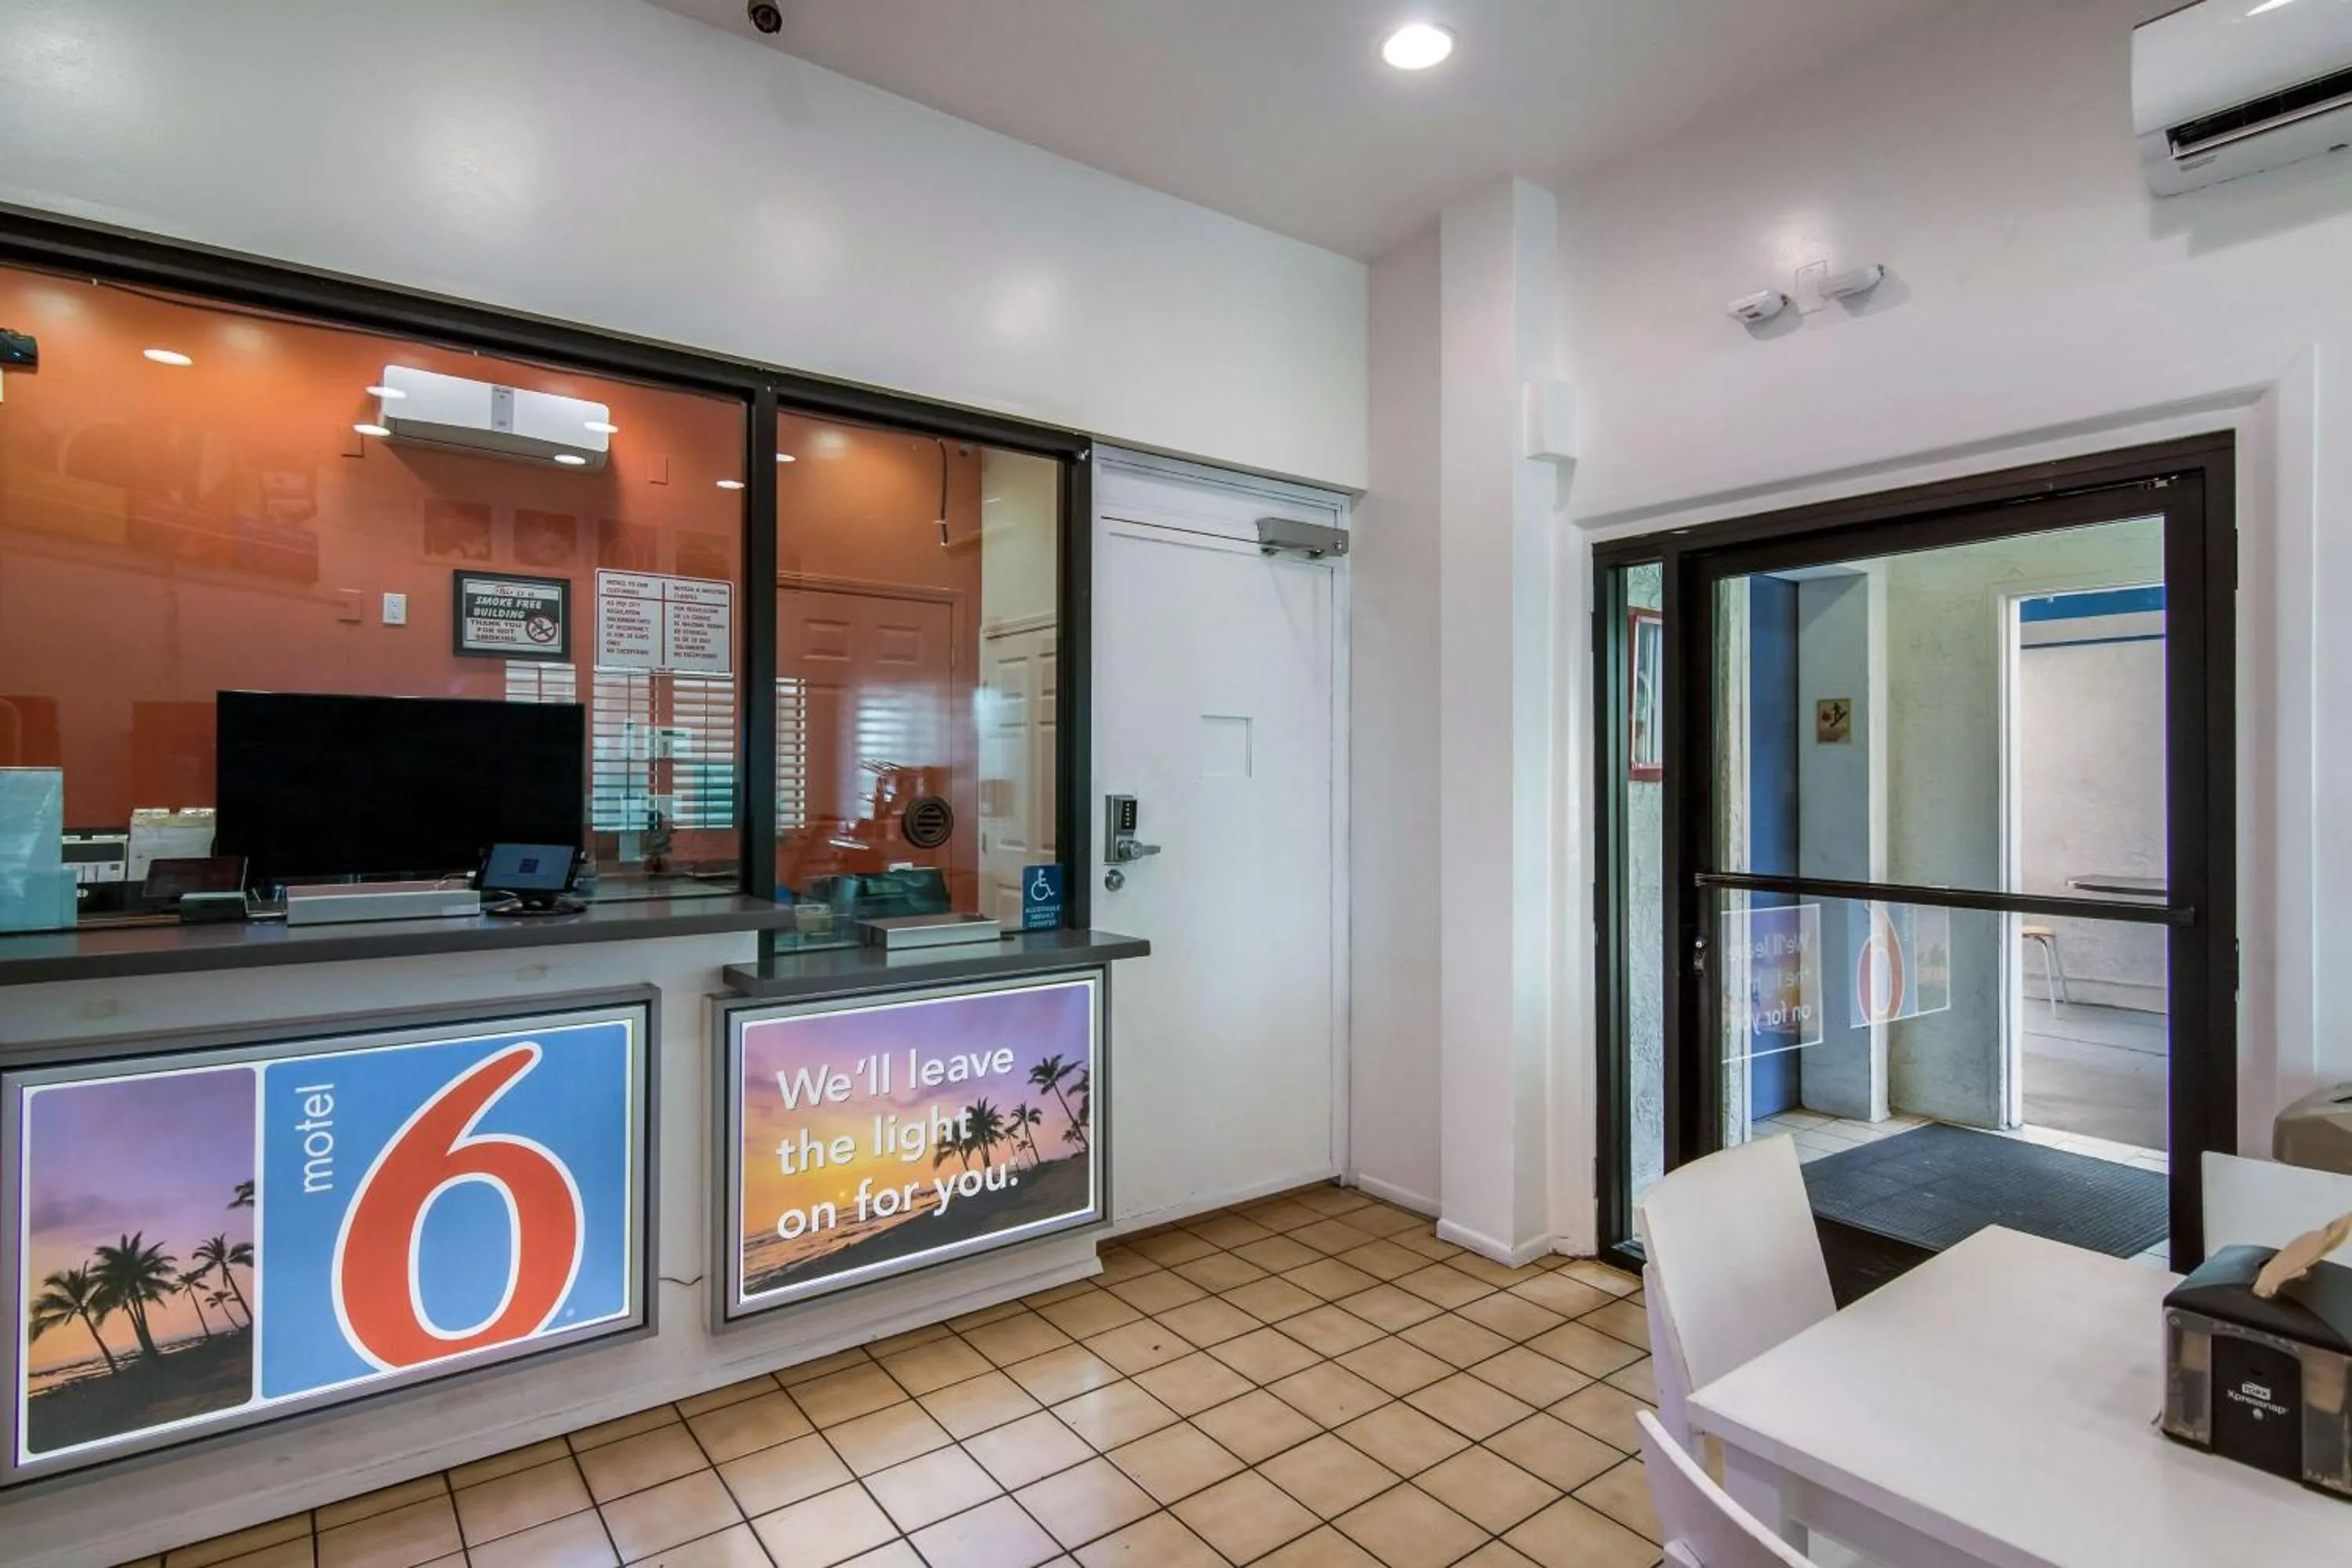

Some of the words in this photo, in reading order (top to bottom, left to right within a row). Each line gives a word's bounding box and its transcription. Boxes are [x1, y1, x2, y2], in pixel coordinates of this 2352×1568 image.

[473, 607, 527, 619] BUILDING
[475, 595, 514, 608] SMOKE
[516, 599, 543, 610] FREE
[475, 633, 517, 642] SMOKING
[775, 1052, 891, 1110] We'll
[909, 1047, 1015, 1090] leave
[295, 1083, 335, 1192] motel
[776, 1129, 856, 1176] the
[873, 1105, 973, 1162] light
[332, 1040, 586, 1373] 6
[777, 1201, 837, 1240] on
[854, 1178, 920, 1222] for
[934, 1163, 1019, 1217] you.
